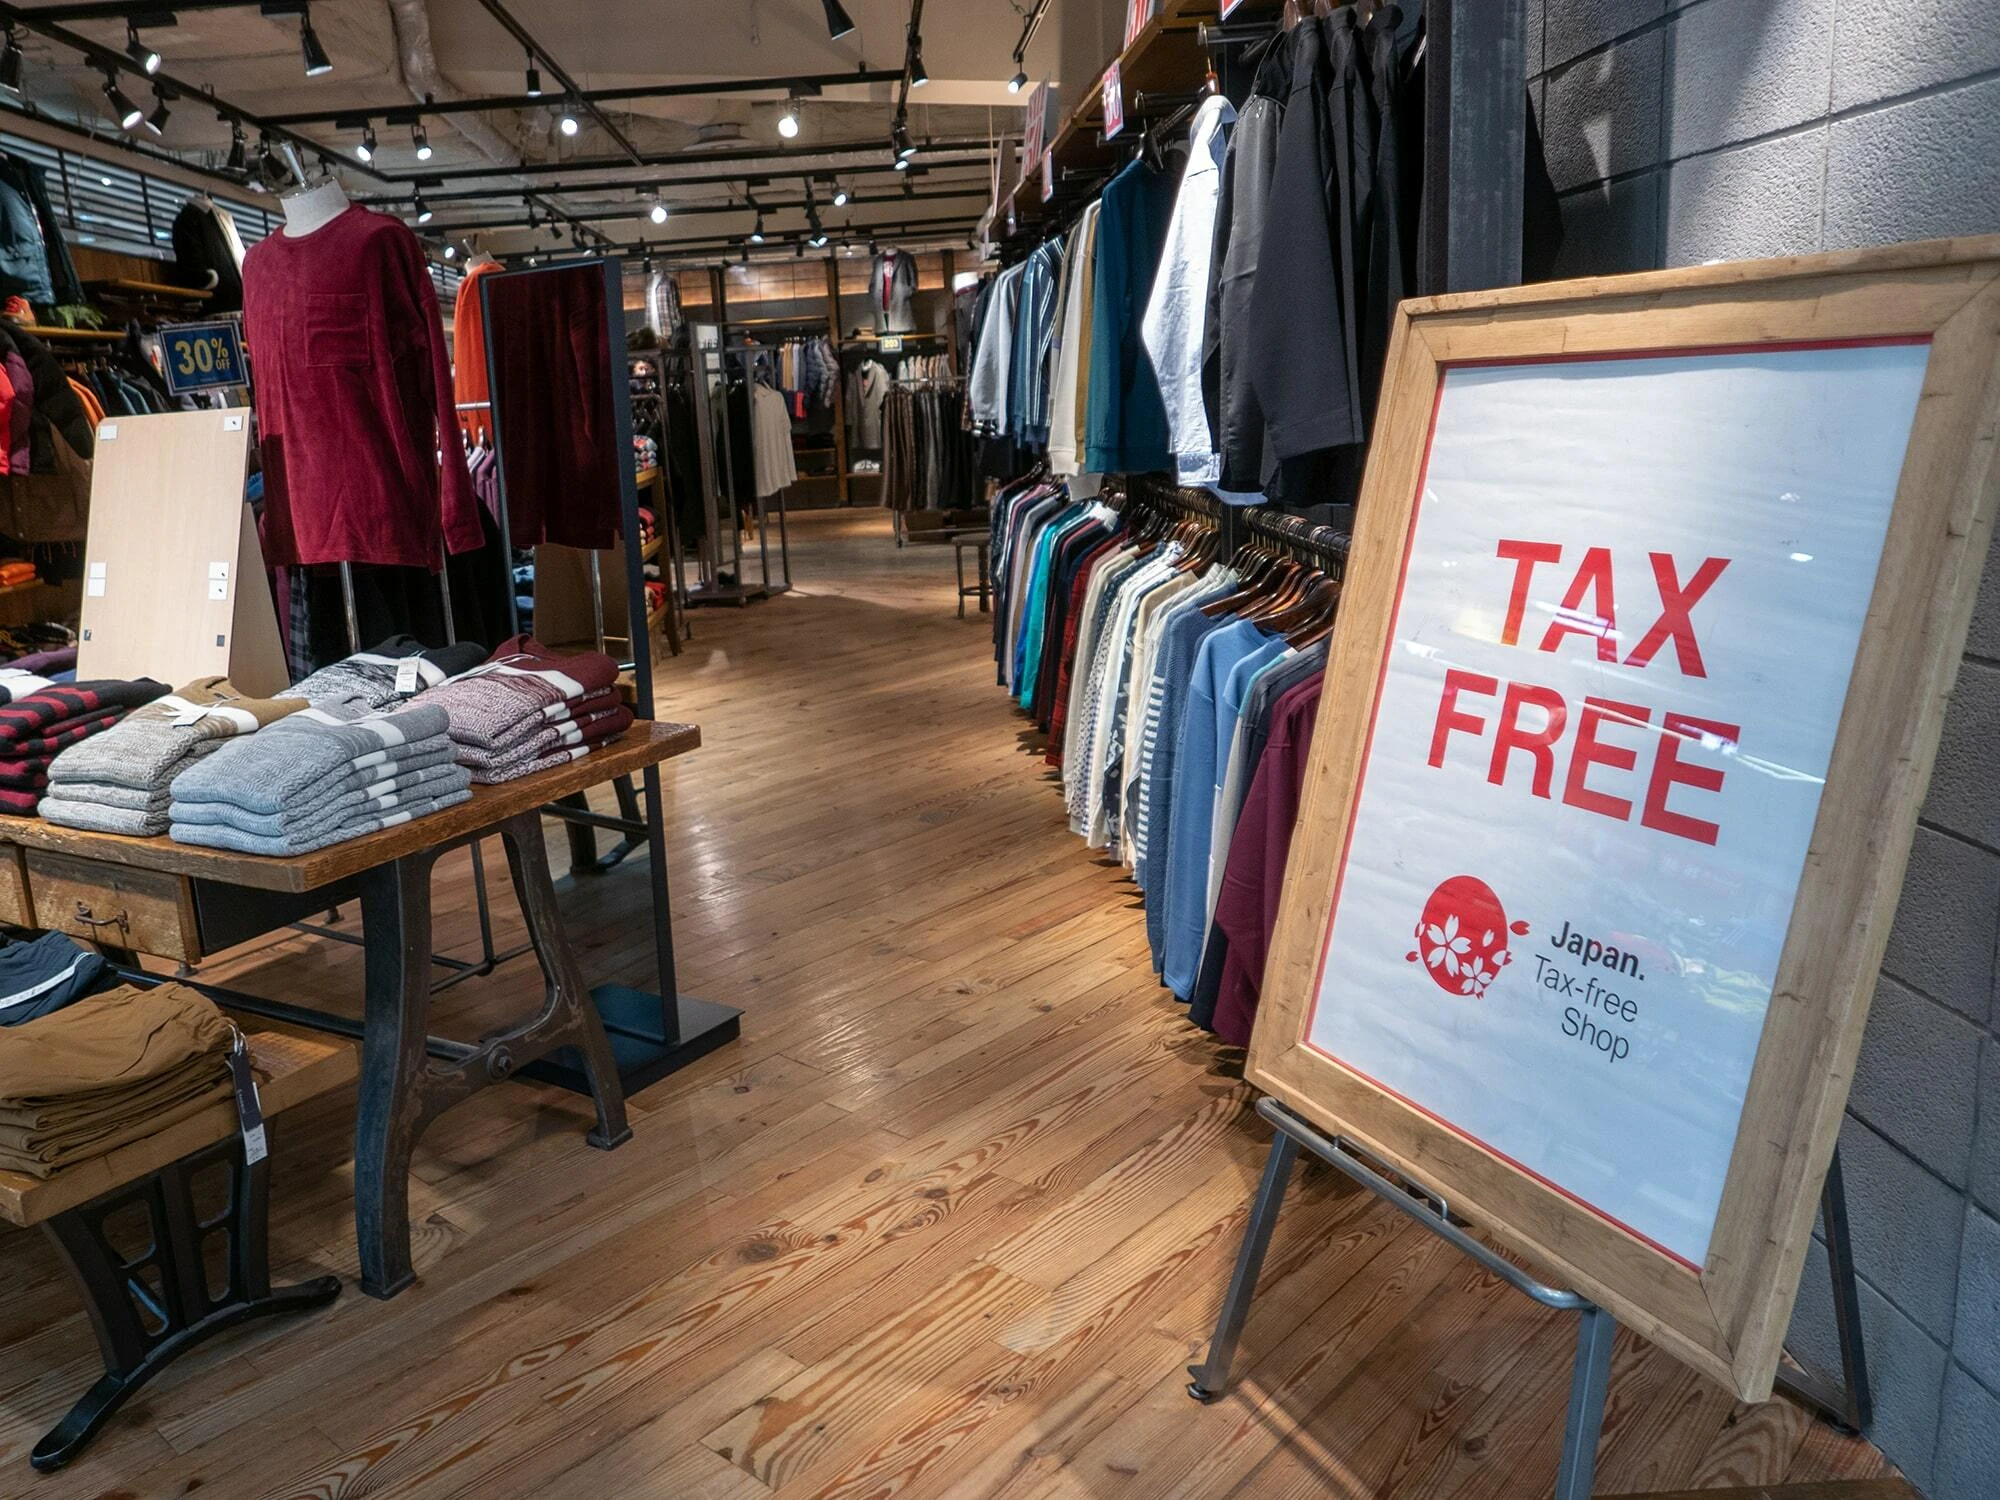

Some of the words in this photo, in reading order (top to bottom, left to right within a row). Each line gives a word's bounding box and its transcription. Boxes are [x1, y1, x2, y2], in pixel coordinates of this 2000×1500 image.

[175, 338, 229, 375] 30%
[216, 359, 231, 371] OFF
[1496, 539, 1732, 679] TAX
[1427, 668, 1740, 846] FREE
[1551, 921, 1645, 981] Japan.
[1535, 953, 1638, 1023] Tax-free
[1561, 1007, 1629, 1063] Shop
